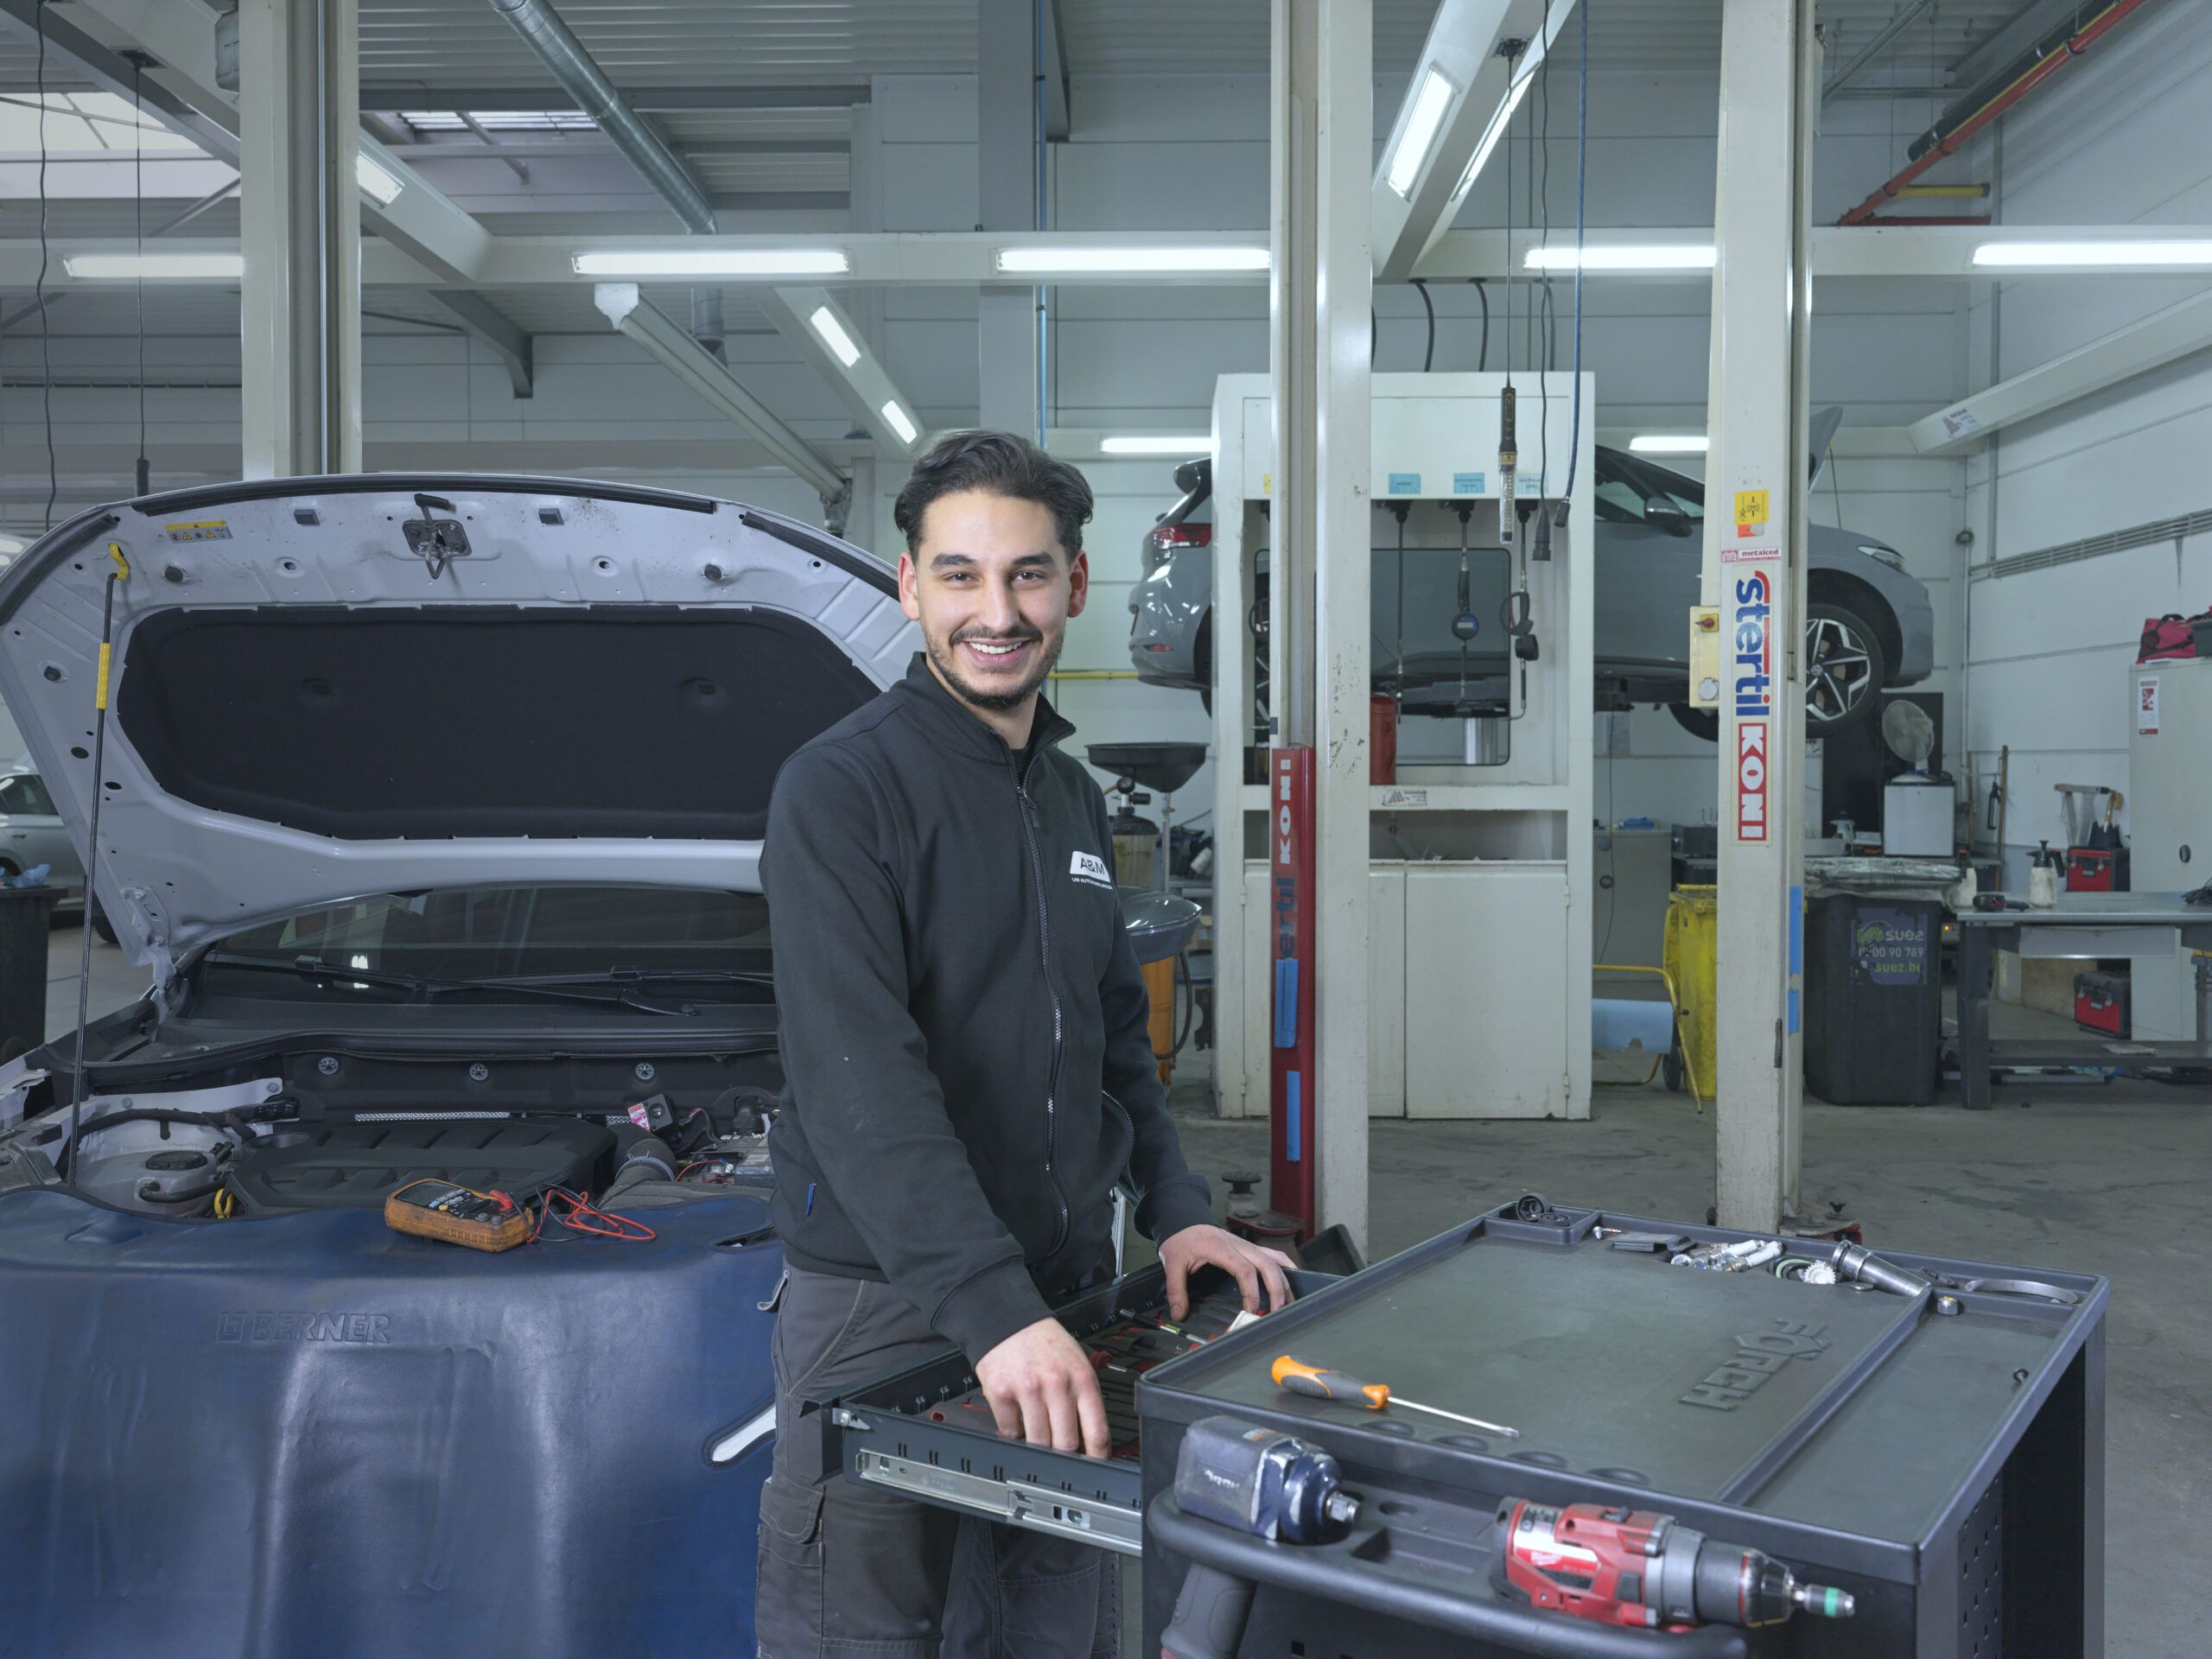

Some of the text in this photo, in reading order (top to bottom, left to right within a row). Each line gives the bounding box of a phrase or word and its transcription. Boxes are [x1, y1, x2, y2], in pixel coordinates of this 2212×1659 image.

[1736, 571, 1770, 716] stertil
[1741, 726, 1764, 839] KONI
[1280, 759, 1292, 865] KONI
[1080, 857, 1105, 876] A&M
[1885, 930, 1924, 941] suez
[1859, 947, 1924, 958] 000 90 789
[251, 1312, 390, 1344] BERNER
